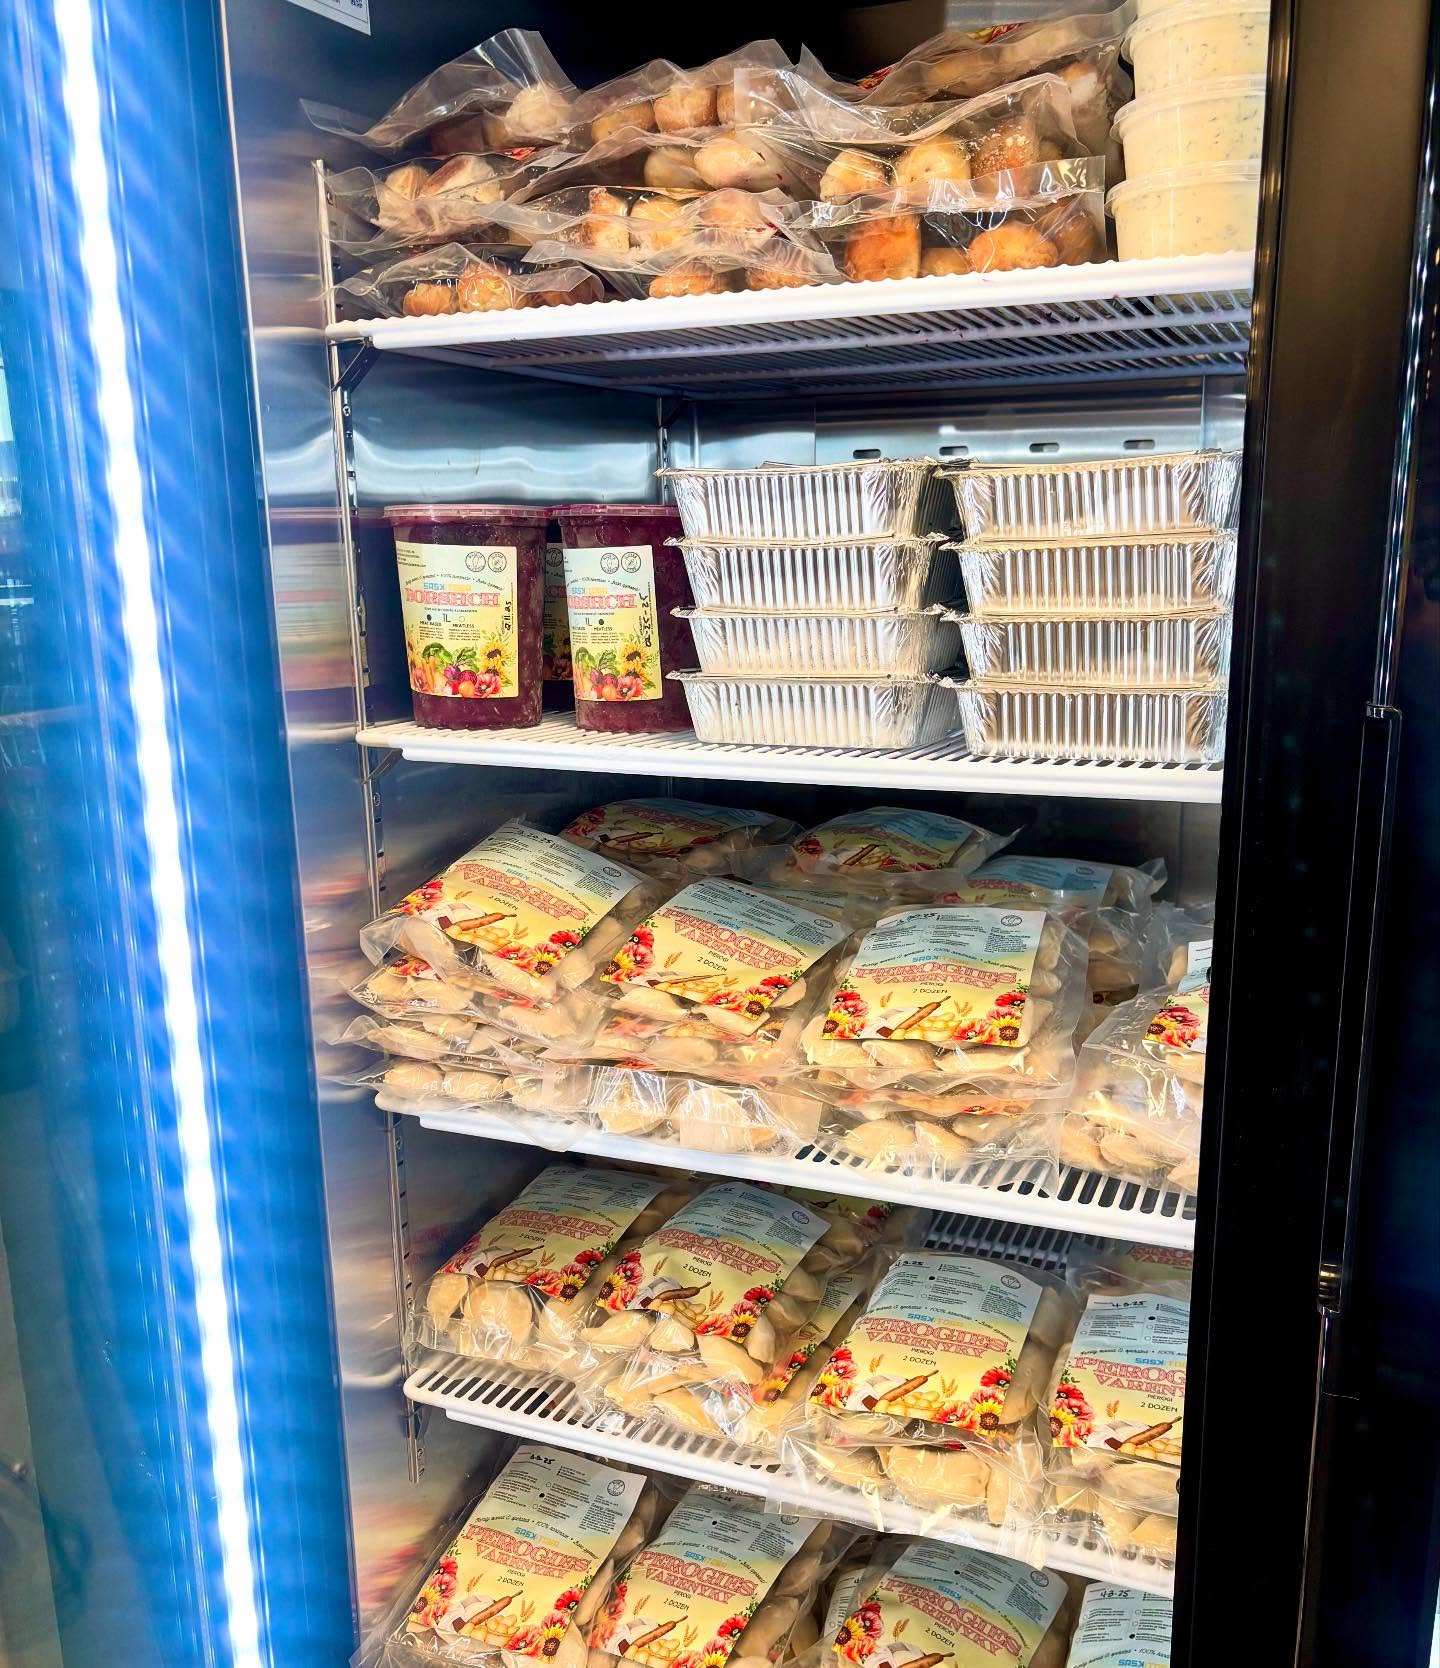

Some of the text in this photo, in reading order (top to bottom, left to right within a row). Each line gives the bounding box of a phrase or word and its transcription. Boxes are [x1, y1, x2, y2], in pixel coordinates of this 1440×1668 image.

[703, 959, 728, 972] DOZEN
[688, 1266, 712, 1278] DOZEN
[909, 1357, 937, 1366] DOZEN
[1148, 1403, 1178, 1412] DOZEN
[502, 1578, 525, 1587] DOZEN
[668, 1600, 690, 1612] DOZEN
[930, 1631, 955, 1648] DOZEN
